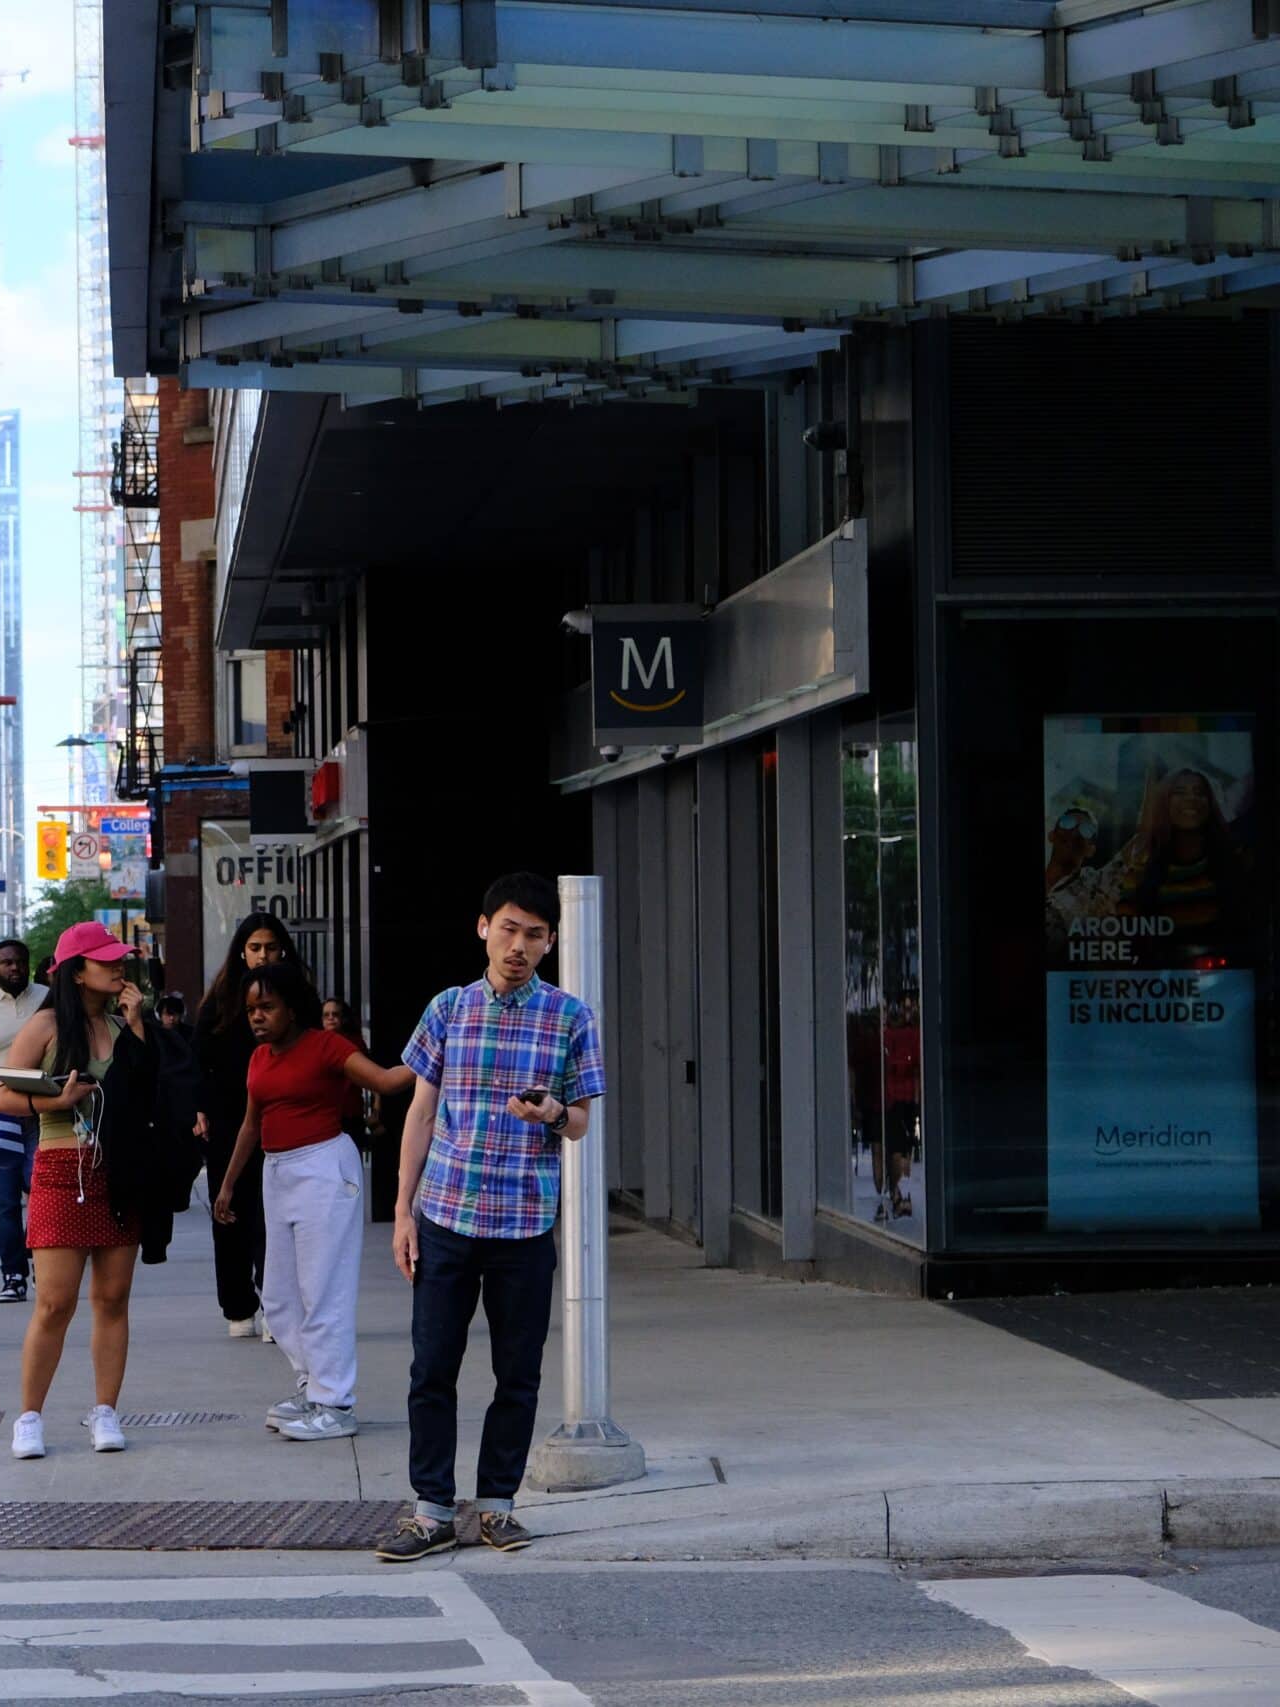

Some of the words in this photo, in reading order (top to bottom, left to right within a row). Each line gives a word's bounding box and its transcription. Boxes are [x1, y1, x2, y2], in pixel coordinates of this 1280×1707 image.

[619, 636, 676, 691] M
[111, 818, 149, 834] Colleg
[1069, 917, 1175, 937] AROUND
[1070, 940, 1140, 964] HERE,
[1070, 979, 1200, 1000] EVERYONE
[1070, 1003, 1091, 1024] IS
[1099, 1002, 1225, 1023] INCLUDED
[1095, 1124, 1211, 1149] Meridian
